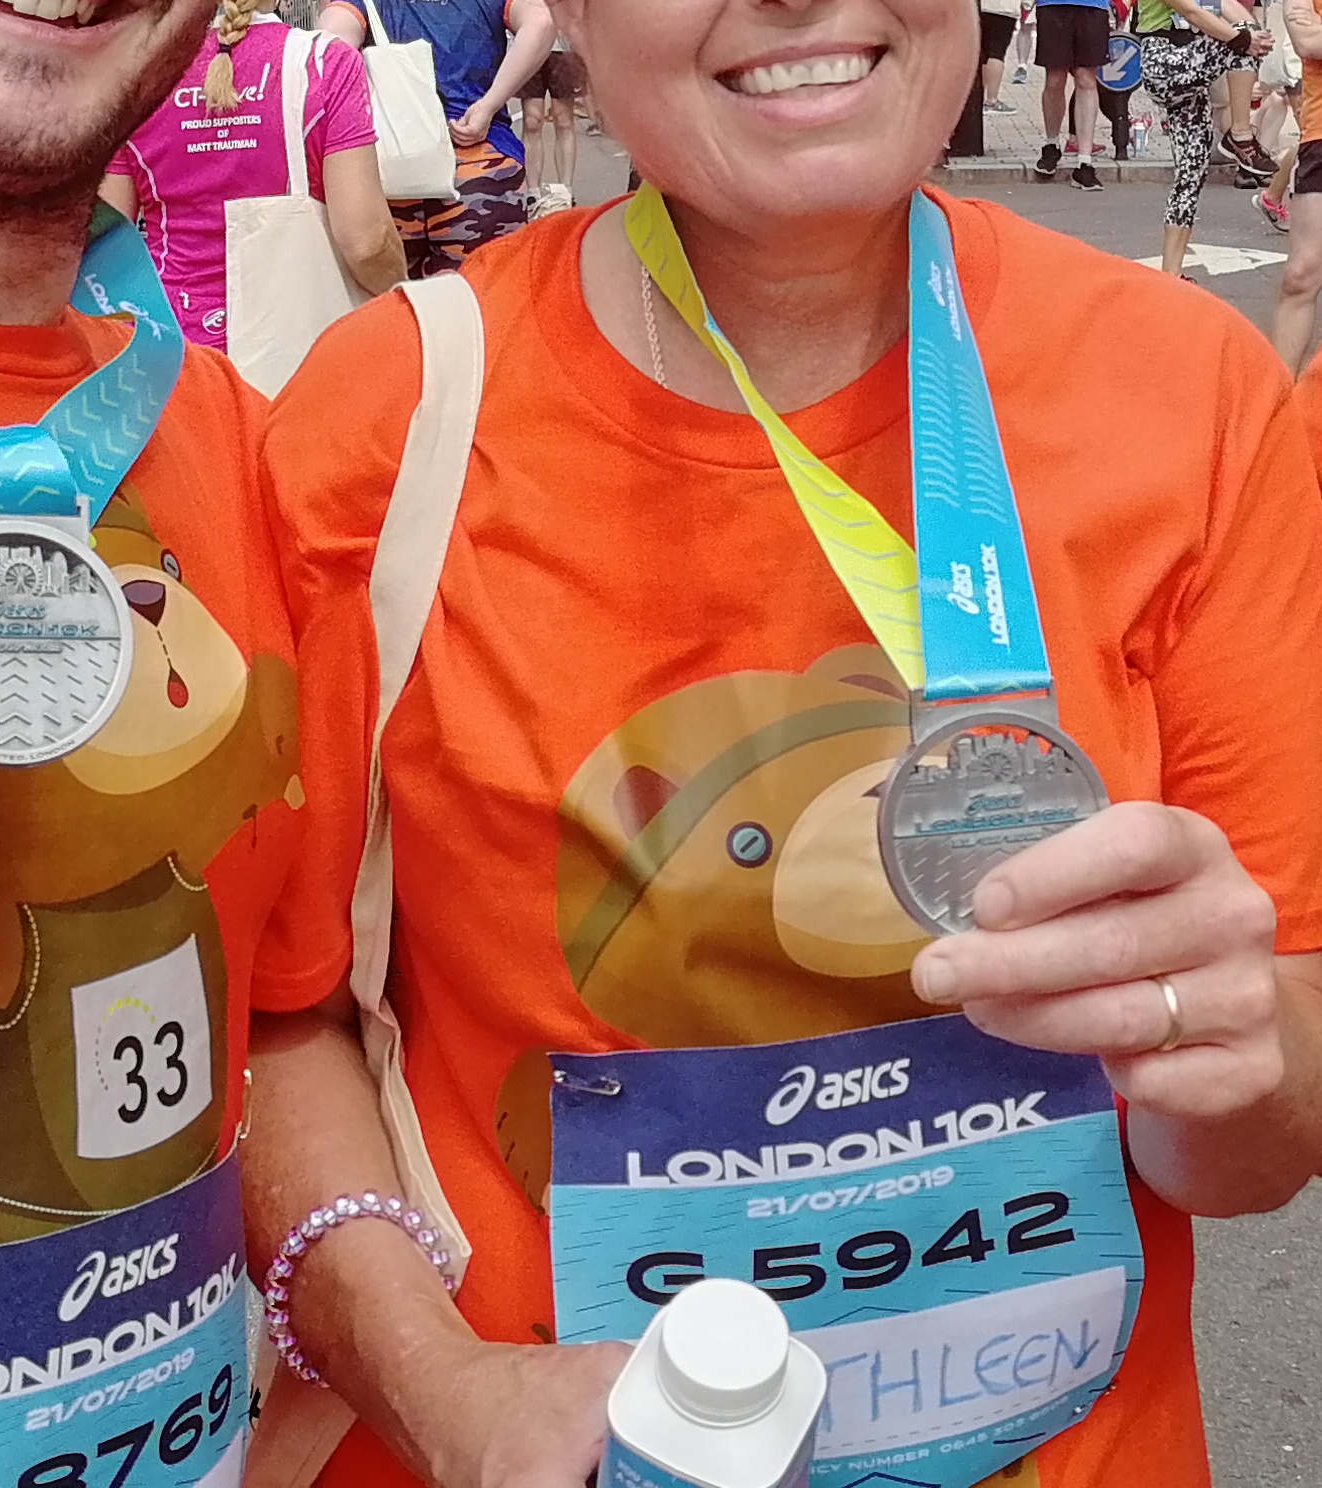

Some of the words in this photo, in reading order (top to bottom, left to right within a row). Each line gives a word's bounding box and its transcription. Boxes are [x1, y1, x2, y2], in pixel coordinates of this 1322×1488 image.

[181, 119, 212, 131] PROUD
[213, 115, 262, 127] SUPPORTERS
[187, 142, 213, 153] MATT
[217, 129, 230, 139] OF
[984, 573, 1010, 647] LONDON
[113, 1021, 188, 1124] 33
[816, 1058, 911, 1110] asics
[627, 1120, 923, 1186] LONDON
[934, 1091, 1053, 1146] 10K
[747, 1165, 955, 1218] 21/07/2019
[101, 1233, 179, 1298] asics
[626, 1252, 705, 1306] G
[753, 1191, 1076, 1302] 5942
[187, 1252, 240, 1326] 10K
[25, 1346, 196, 1431] 21/07/2019
[815, 1318, 1099, 1433] THLEEN
[848, 1448, 930, 1470] NUMBER
